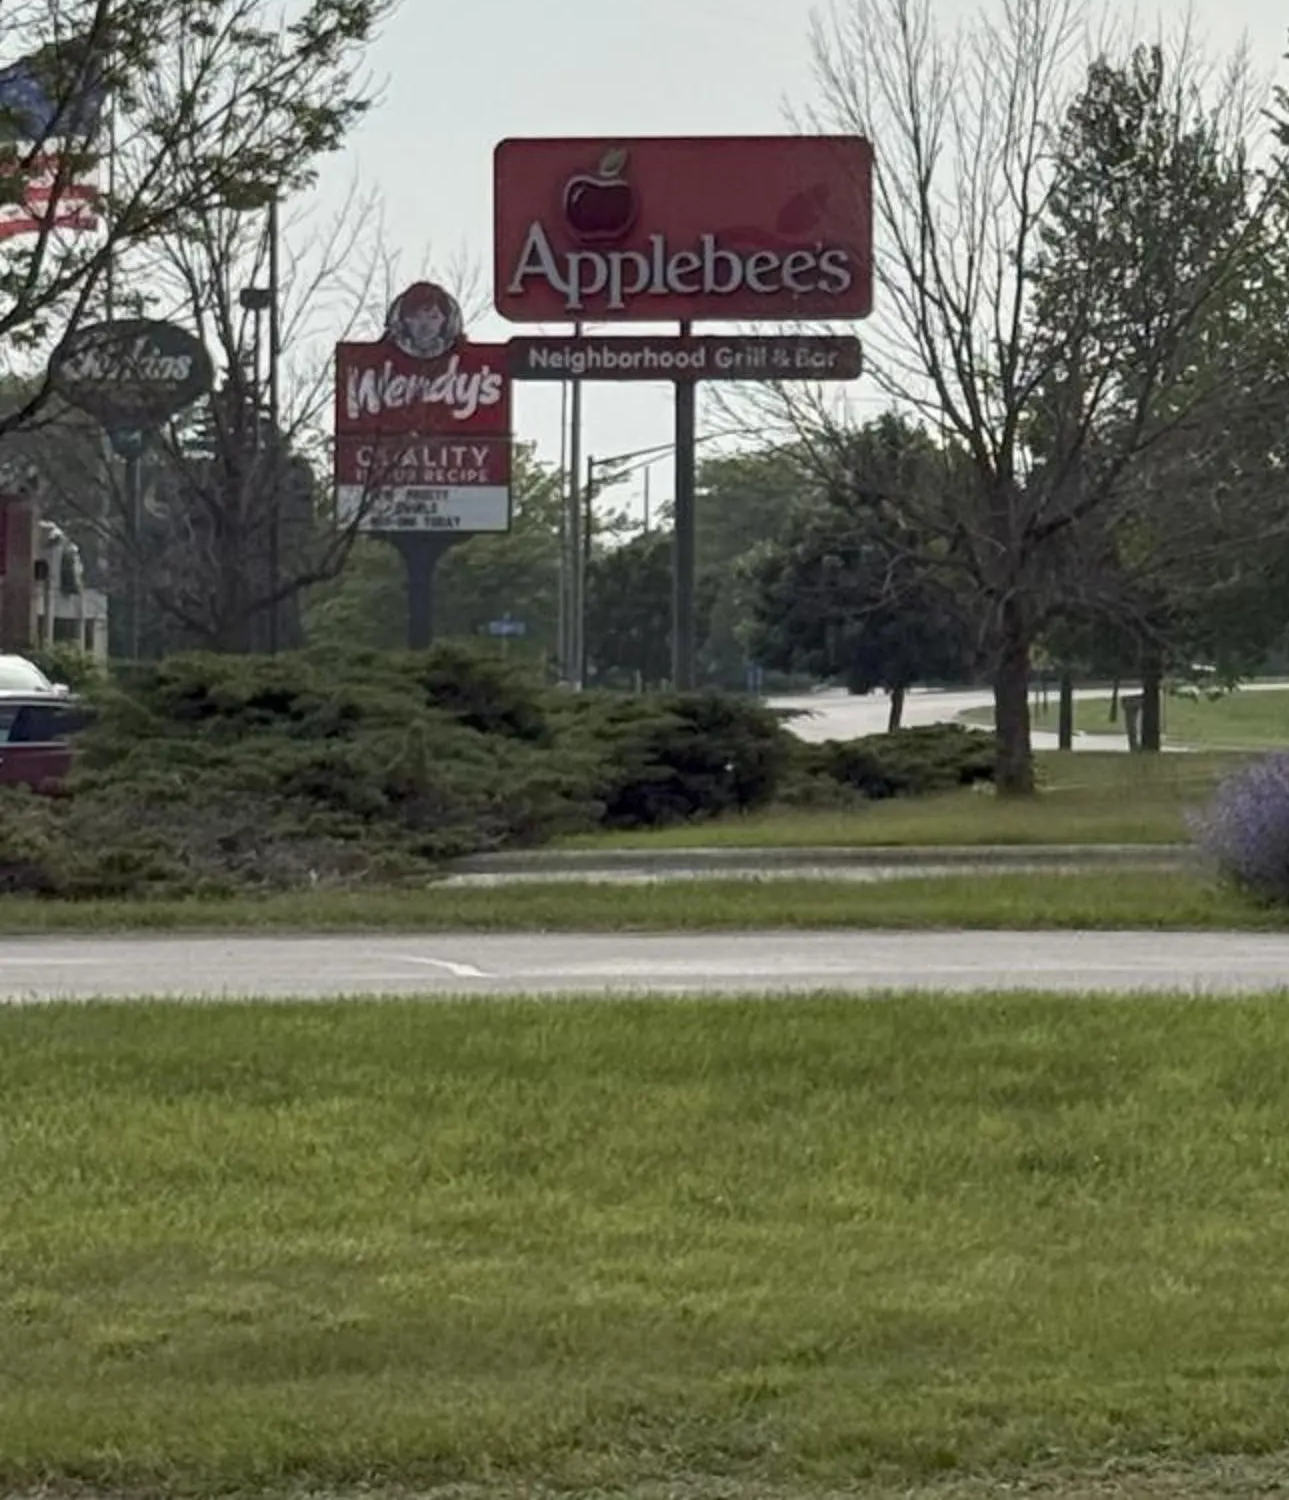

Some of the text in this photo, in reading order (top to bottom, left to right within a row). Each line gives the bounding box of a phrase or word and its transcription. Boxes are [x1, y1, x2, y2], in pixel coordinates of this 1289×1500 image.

[507, 220, 851, 311] Applebee's
[528, 346, 839, 373] Neighborhood Grill & Bar
[355, 445, 490, 468] QALITY
[423, 468, 489, 483] RECIPE
